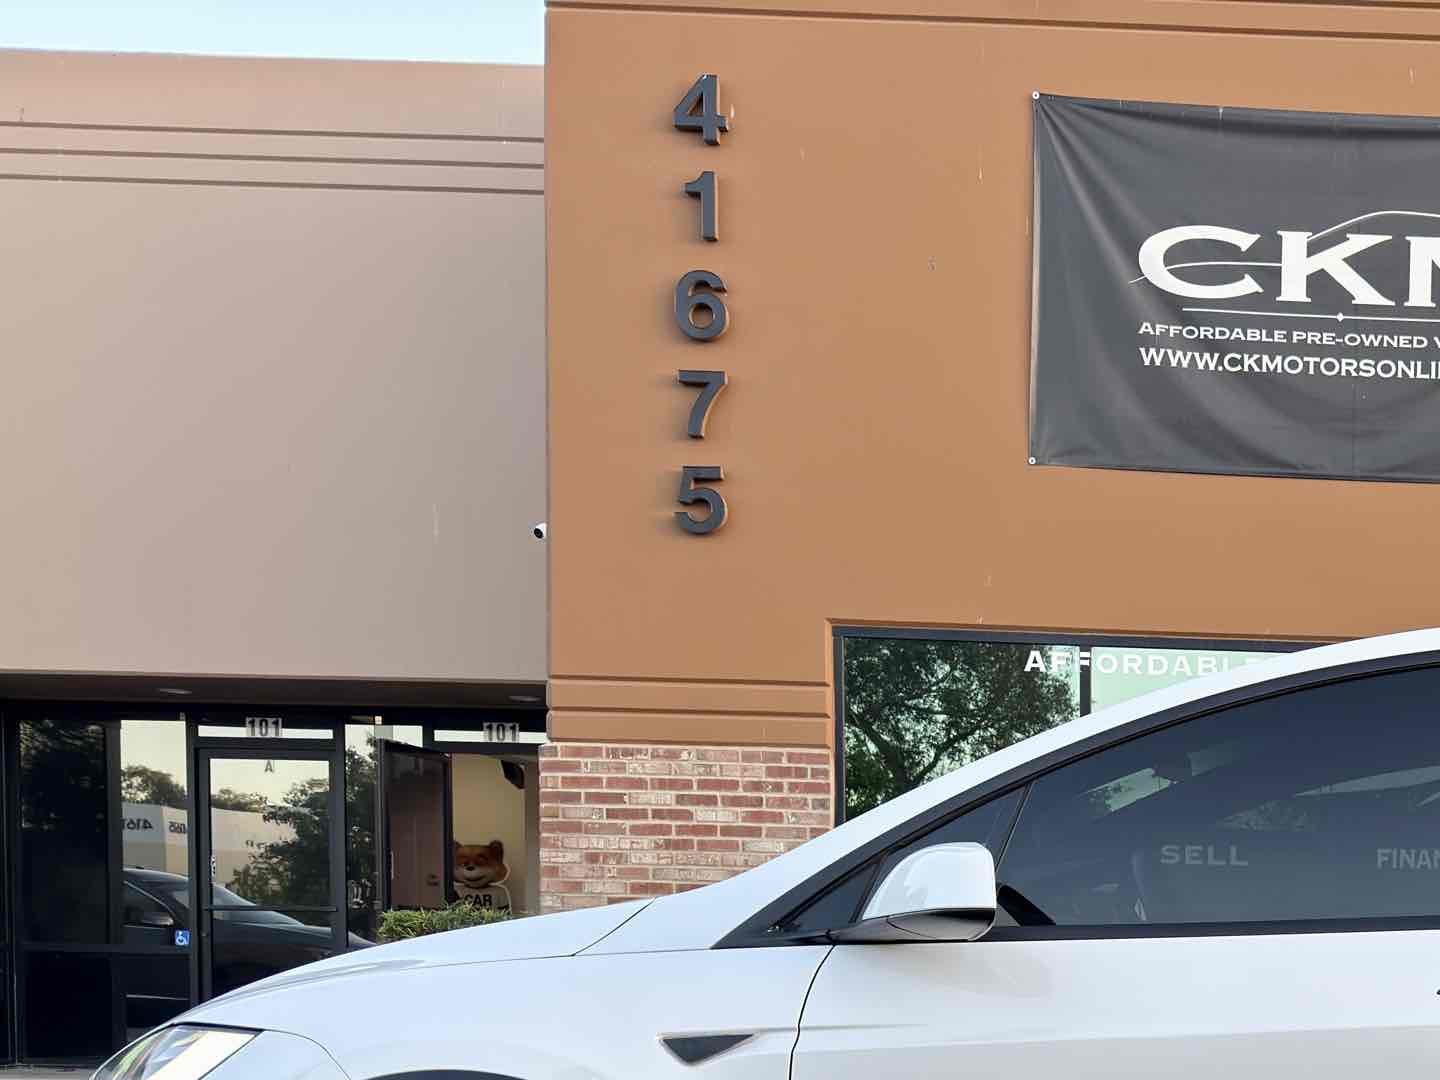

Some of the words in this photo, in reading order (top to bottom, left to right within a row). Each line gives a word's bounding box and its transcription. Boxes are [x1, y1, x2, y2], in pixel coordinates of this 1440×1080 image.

[1138, 322, 1287, 344] AFFORDABLE
[1292, 329, 1429, 350] PRE-OWNED
[247, 718, 280, 737] 101
[486, 723, 517, 742] 101
[1160, 845, 1249, 866] SELL
